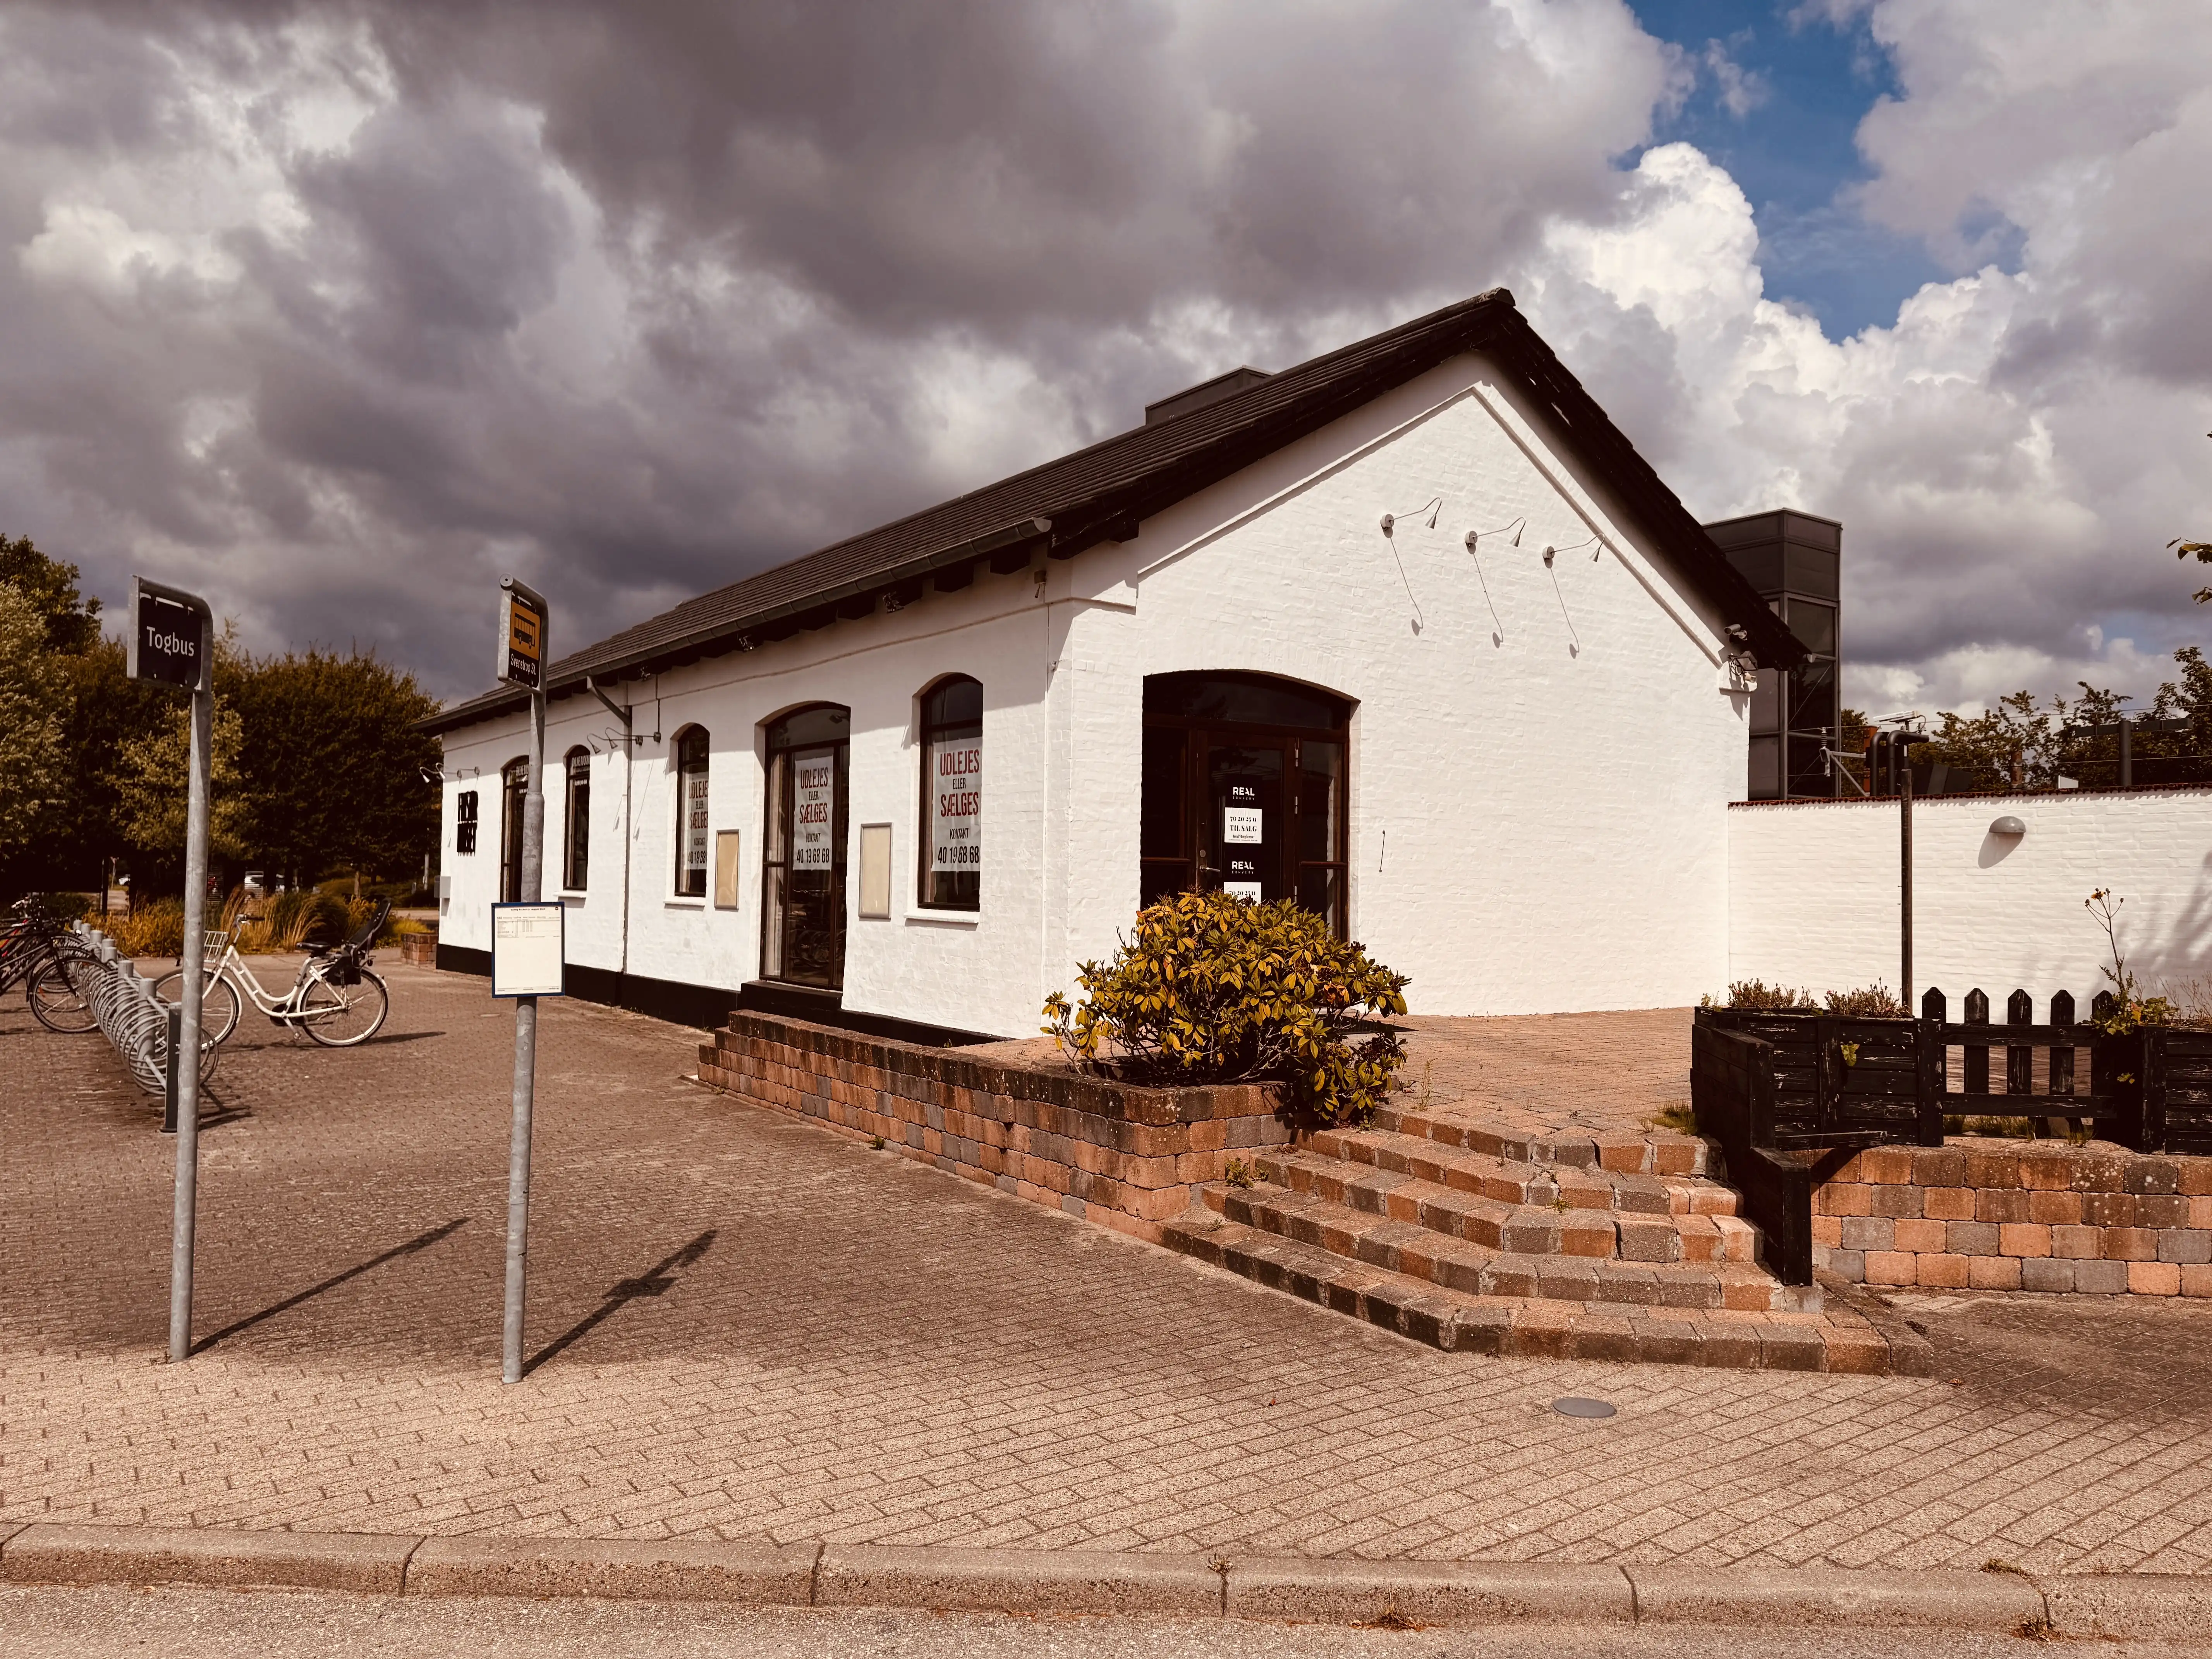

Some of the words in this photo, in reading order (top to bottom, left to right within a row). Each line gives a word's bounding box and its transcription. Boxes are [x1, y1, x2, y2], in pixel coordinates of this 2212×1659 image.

[146, 626, 194, 656] Togbus
[511, 653, 531, 675] Svenstrup
[940, 749, 979, 776] UDLEJES
[800, 767, 828, 789] UDLEJES
[953, 778, 966, 790] ELLER
[689, 780, 708, 799] UDLEJE
[809, 791, 819, 801] ELLER
[1233, 787, 1255, 796] REAL
[799, 802, 828, 824] SÆLGES
[941, 791, 979, 817] SÆLGES
[950, 828, 969, 840] KONTAKT
[797, 848, 804, 864] 40
[805, 848, 812, 863] 19
[813, 848, 820, 863] 68
[822, 848, 829, 863] 68
[938, 847, 947, 864] 40
[950, 846, 957, 864] 19
[958, 846, 967, 864] 68
[970, 846, 979, 864] 68
[1232, 861, 1254, 870] REAL
